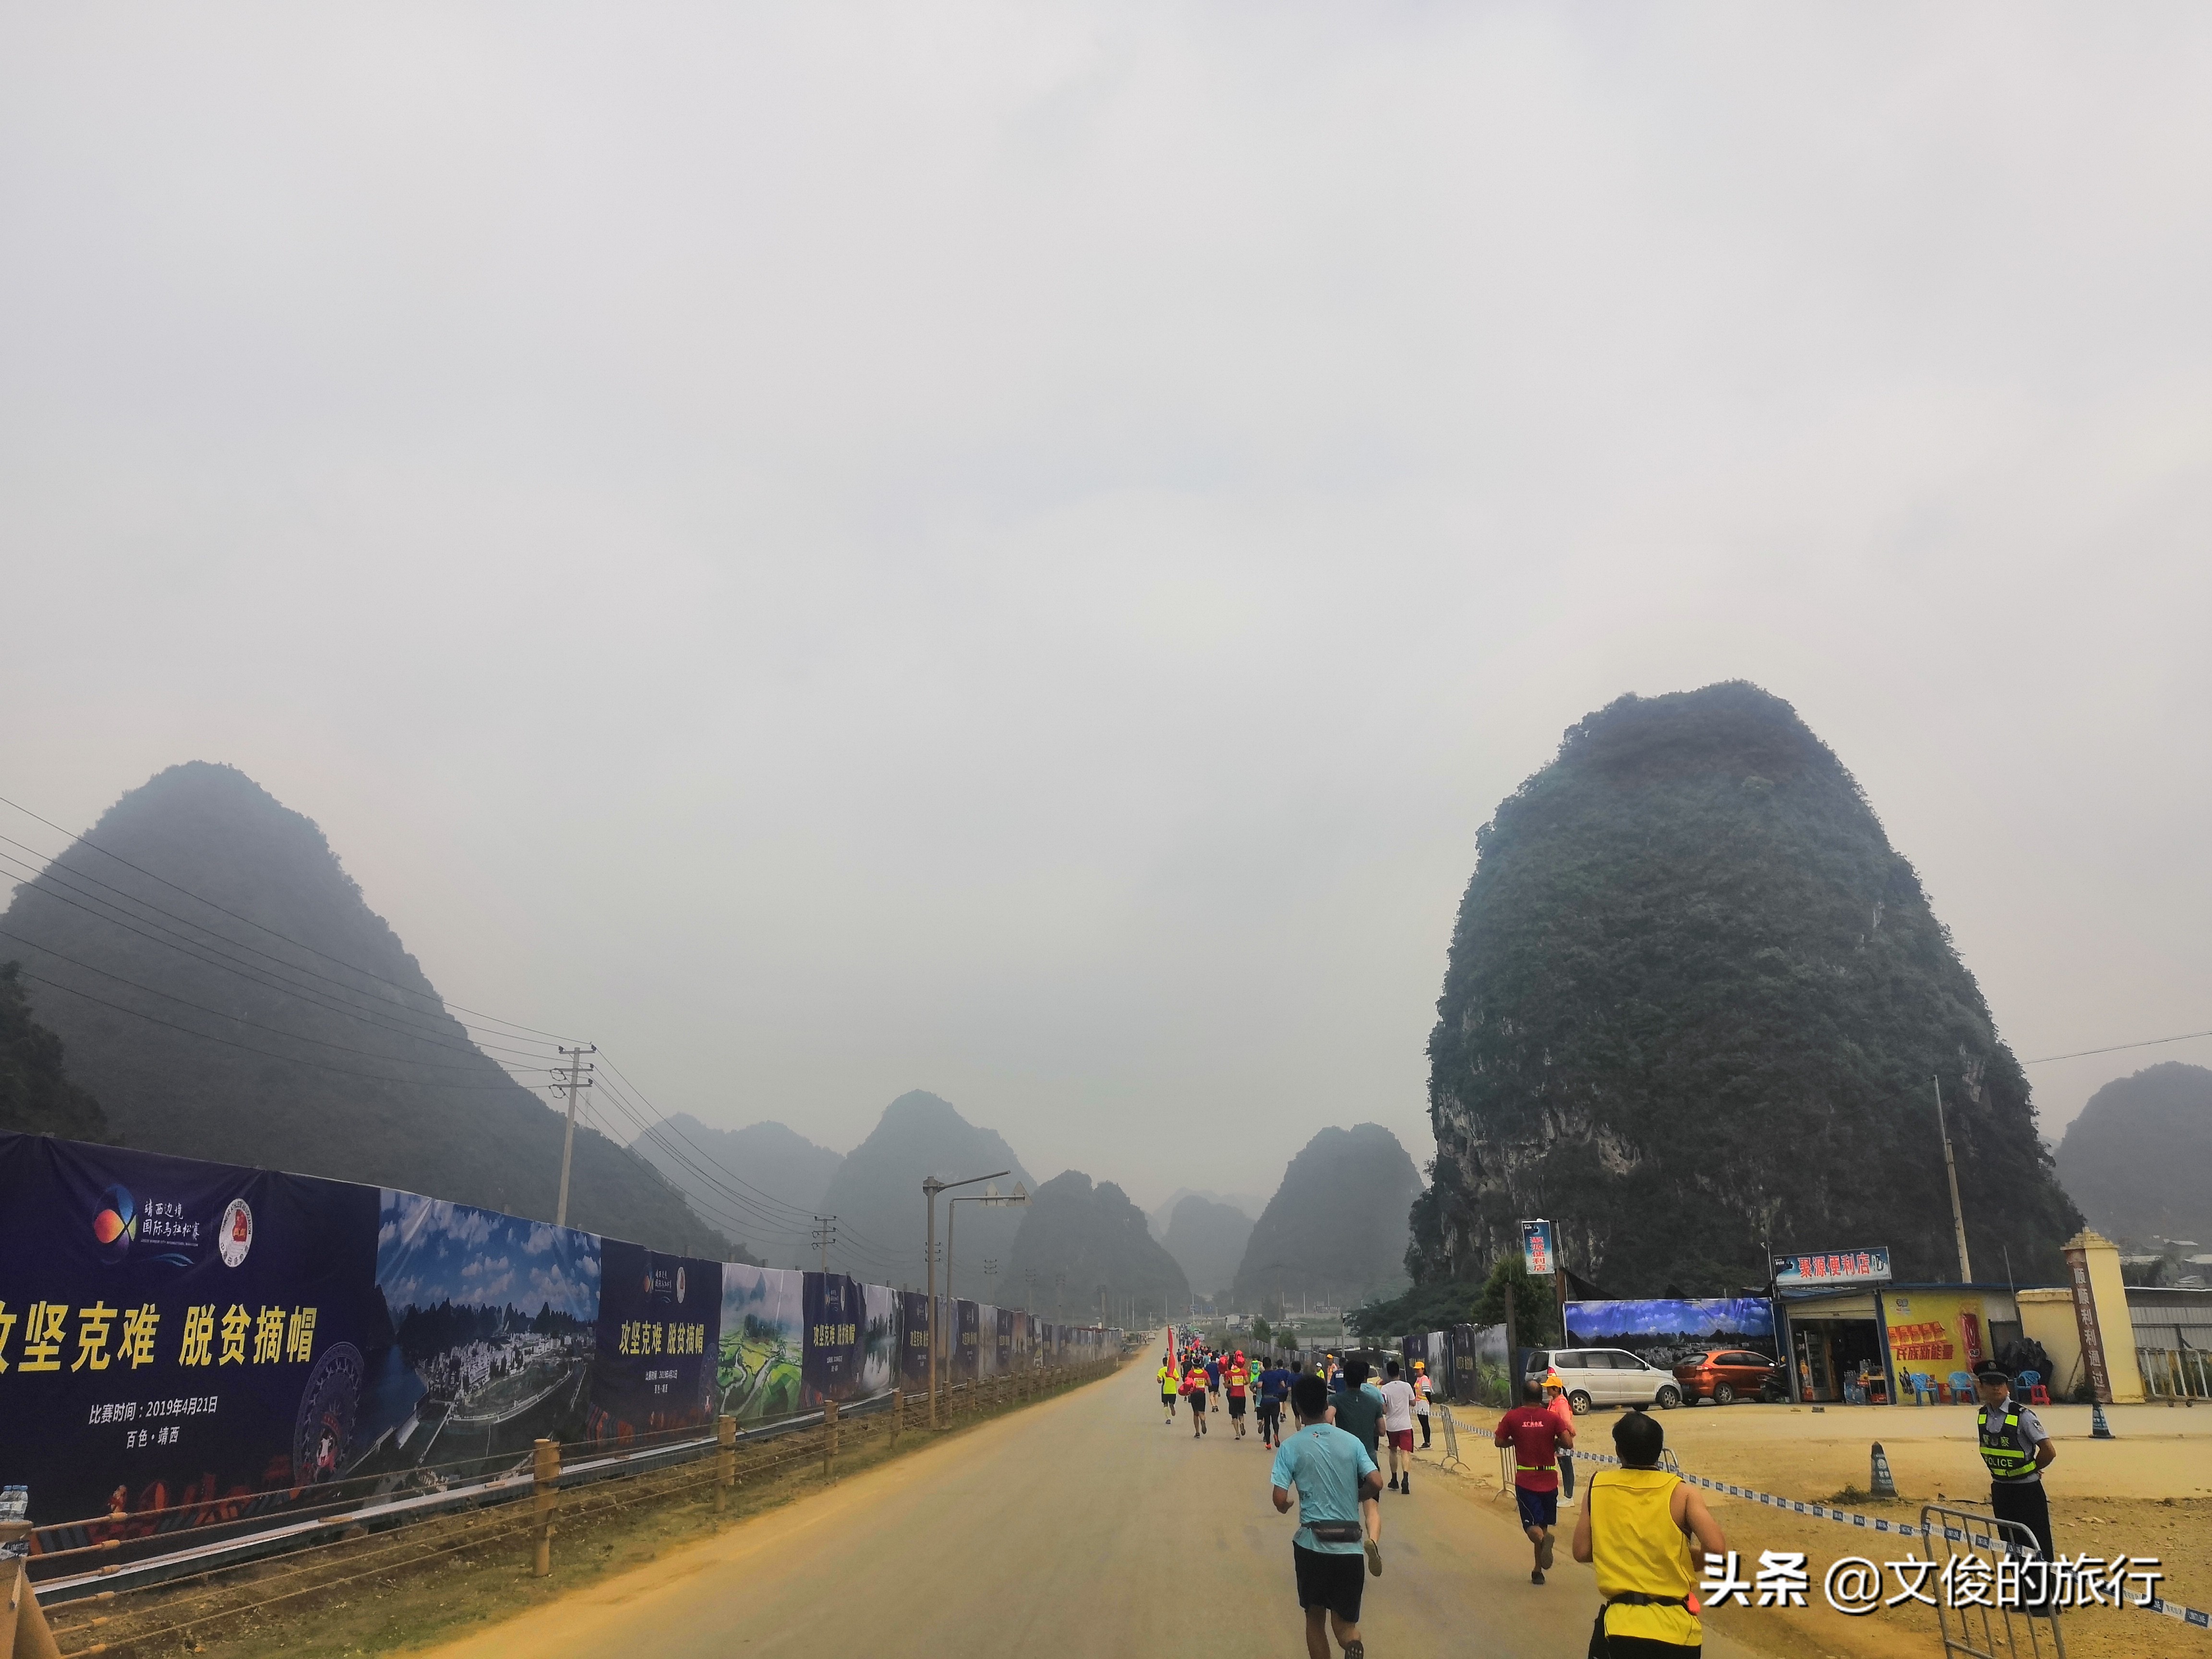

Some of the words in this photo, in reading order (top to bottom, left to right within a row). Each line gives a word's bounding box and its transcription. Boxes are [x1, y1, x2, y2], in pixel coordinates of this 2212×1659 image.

[144, 1199, 183, 1219] 靖西边境
[143, 1219, 200, 1240] 国际马拉松赛
[1529, 1237, 1546, 1271] 聚源便利店
[1798, 1251, 1870, 1278] 聚源便利店
[179, 1303, 317, 1367] 脱贫摘帽
[619, 1320, 662, 1355] 攻坚克难
[667, 1322, 704, 1355] 脱贫摘帽
[2073, 1267, 2105, 1388] 顺顺利利通过
[1897, 1344, 1953, 1360] 民族新能量
[1984, 1456, 2013, 1467] POLICE
